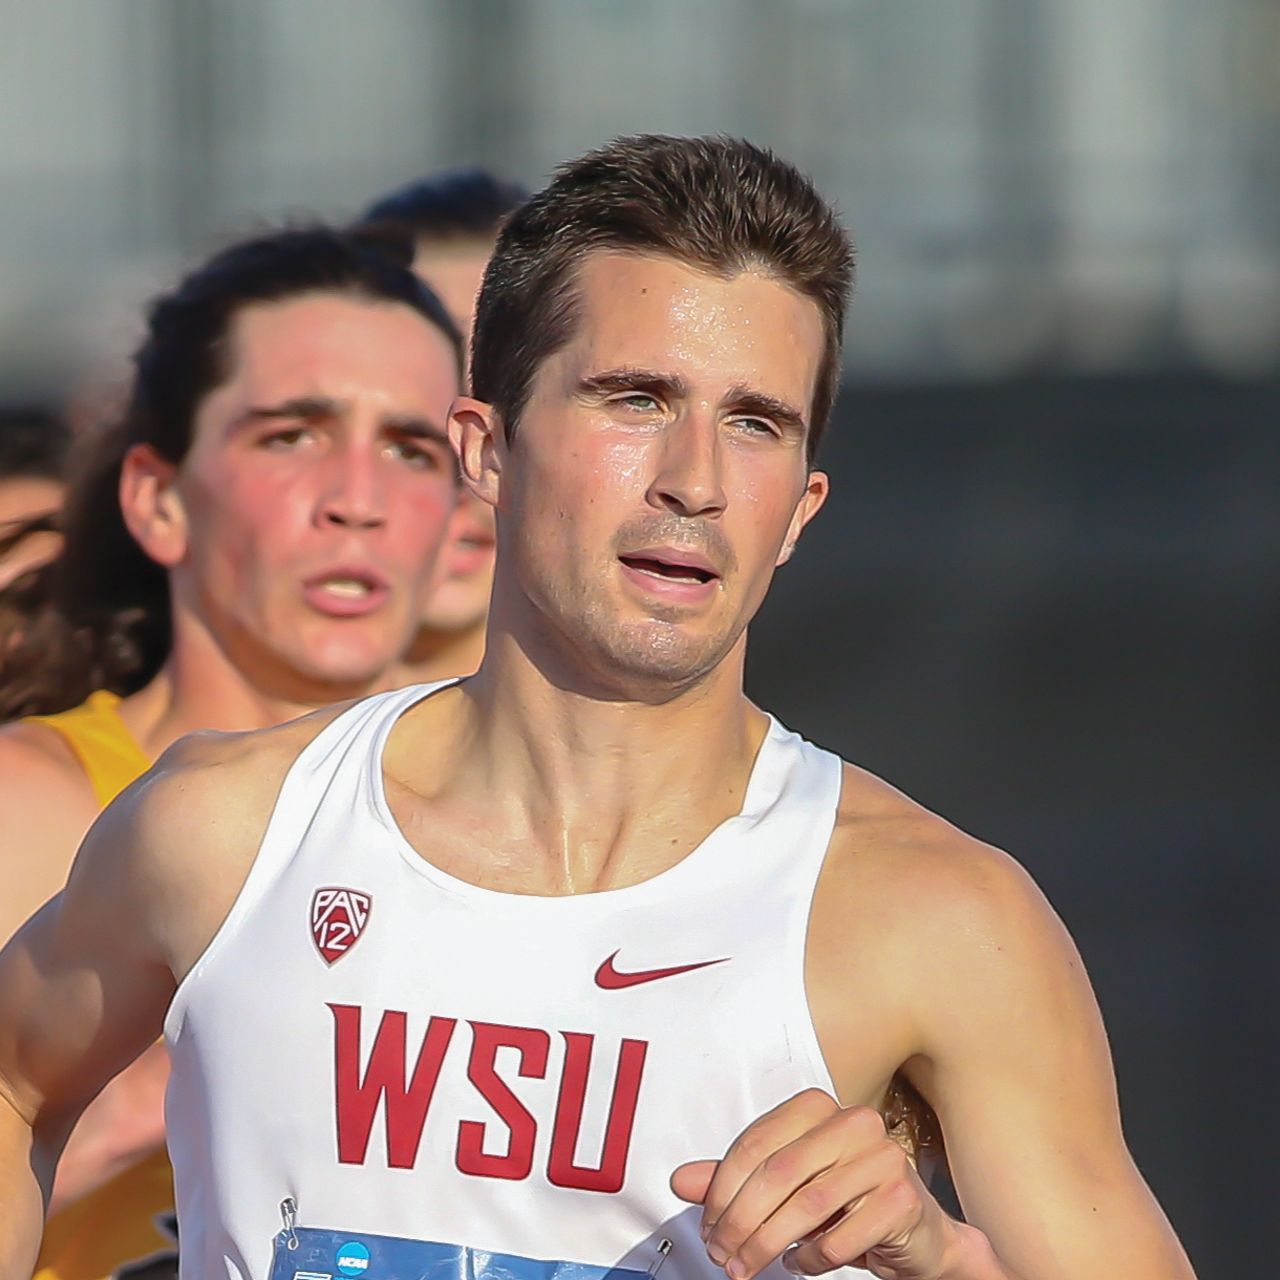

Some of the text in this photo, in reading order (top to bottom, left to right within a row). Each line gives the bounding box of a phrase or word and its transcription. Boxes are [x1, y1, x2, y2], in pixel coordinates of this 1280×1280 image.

[313, 890, 369, 938] PAC
[319, 921, 351, 951] 12
[324, 1002, 649, 1194] WSU
